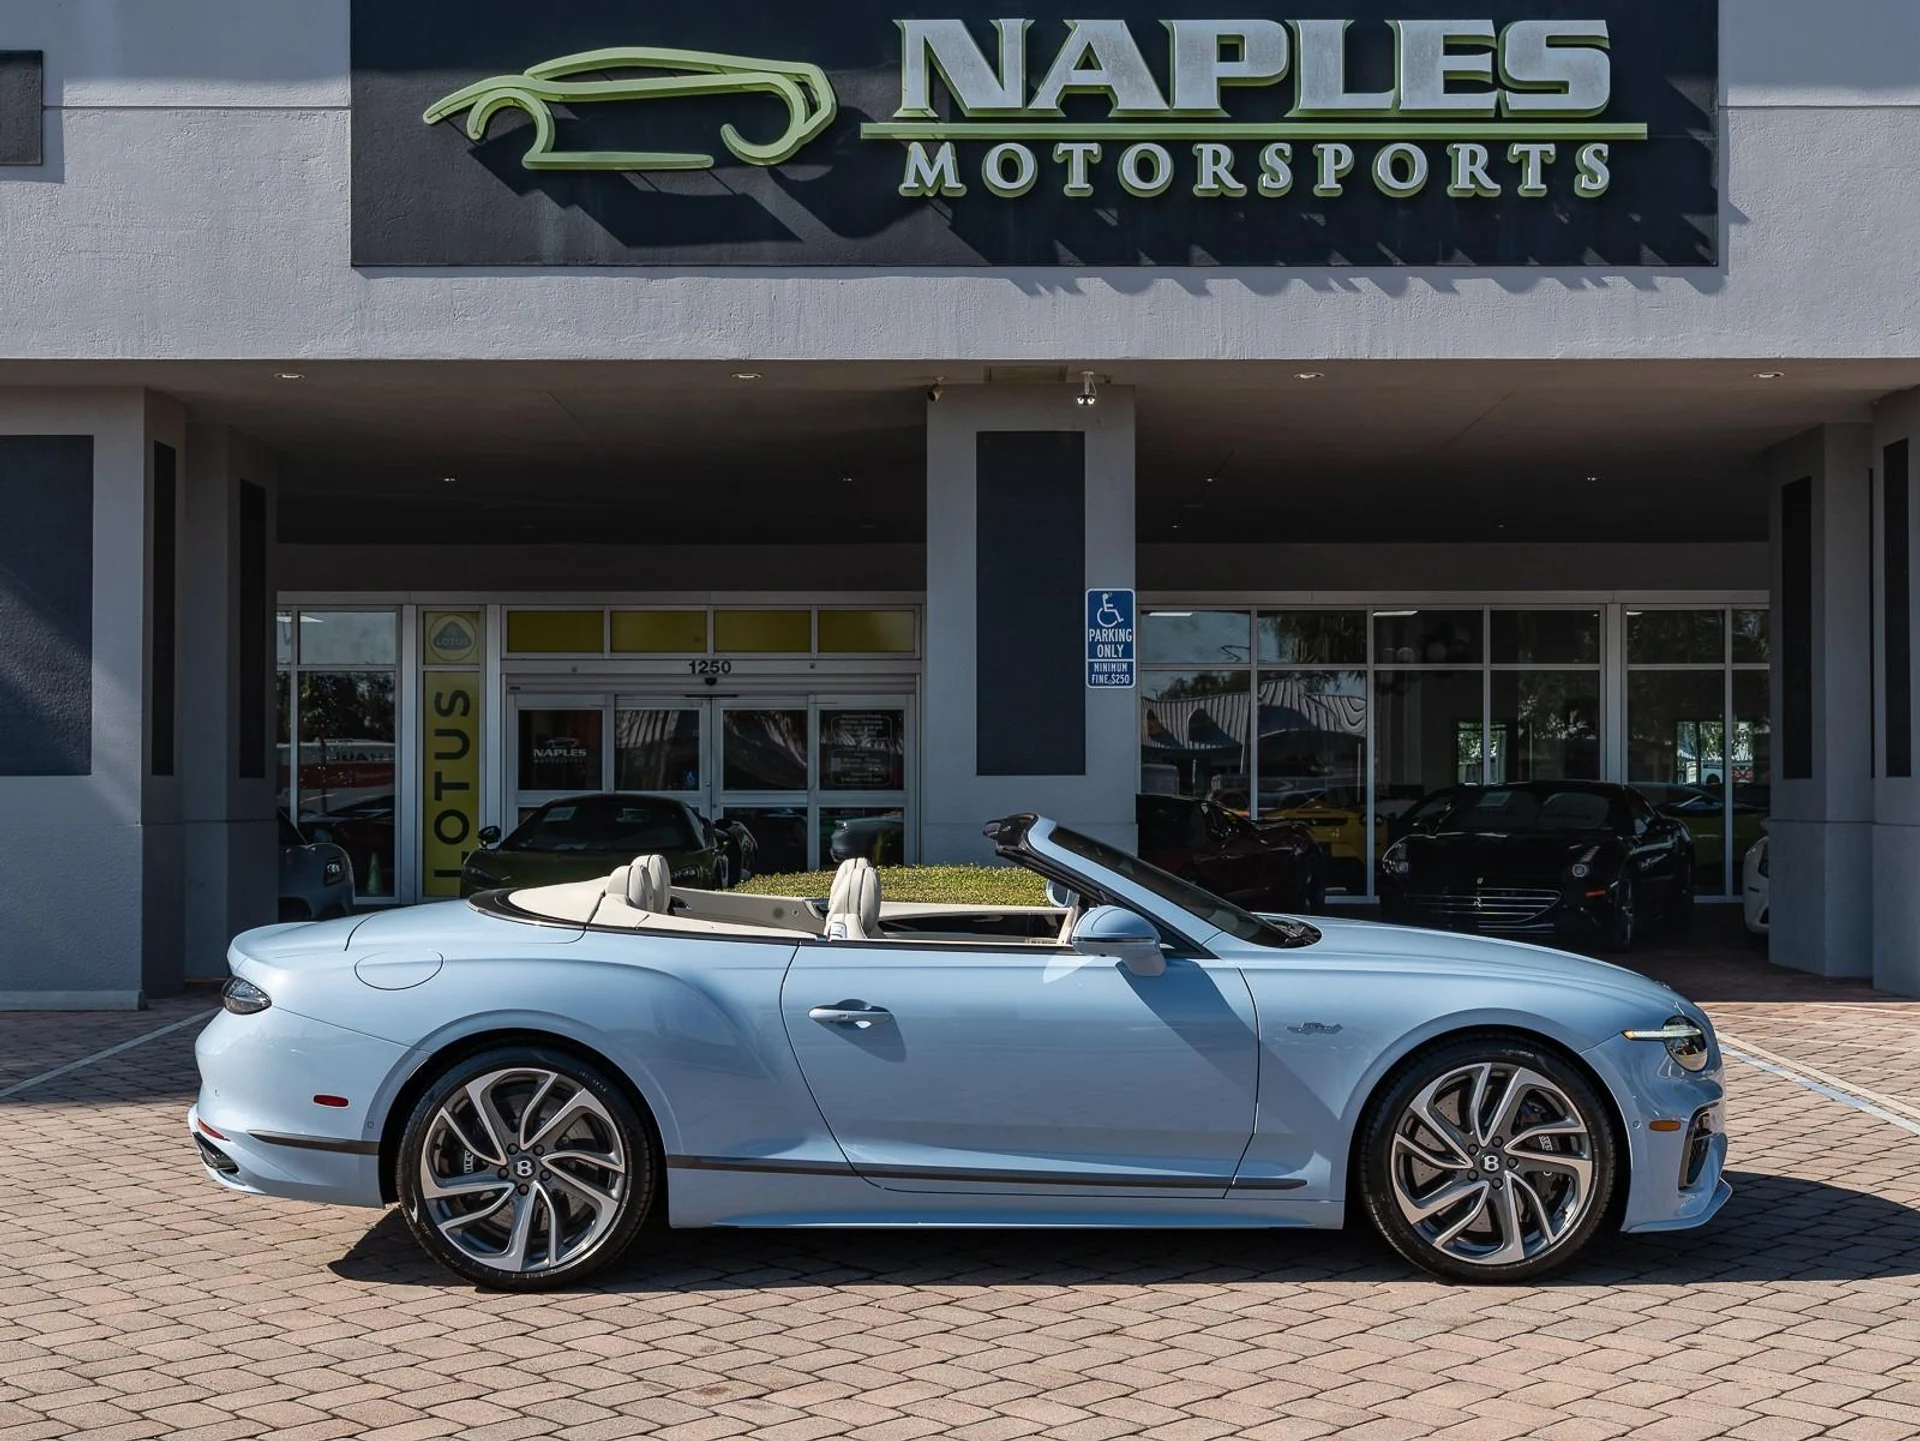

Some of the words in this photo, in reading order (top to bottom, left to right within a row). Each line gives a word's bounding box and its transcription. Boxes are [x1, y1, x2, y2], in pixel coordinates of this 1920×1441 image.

[892, 19, 1611, 118] NAPLES
[899, 142, 1610, 198] MOTORSPORTS
[436, 638, 469, 646] LOTUS
[1089, 628, 1132, 642] PARKING
[1097, 644, 1124, 658] ONLY
[689, 660, 732, 676] 1250
[1094, 662, 1128, 673] MINIMUM
[1092, 674, 1109, 684] FINE
[1111, 673, 1130, 685] $250
[533, 748, 587, 757] NAPLES
[434, 688, 471, 878] LOTUS
[517, 1160, 533, 1176] B
[1484, 1155, 1499, 1171] B
